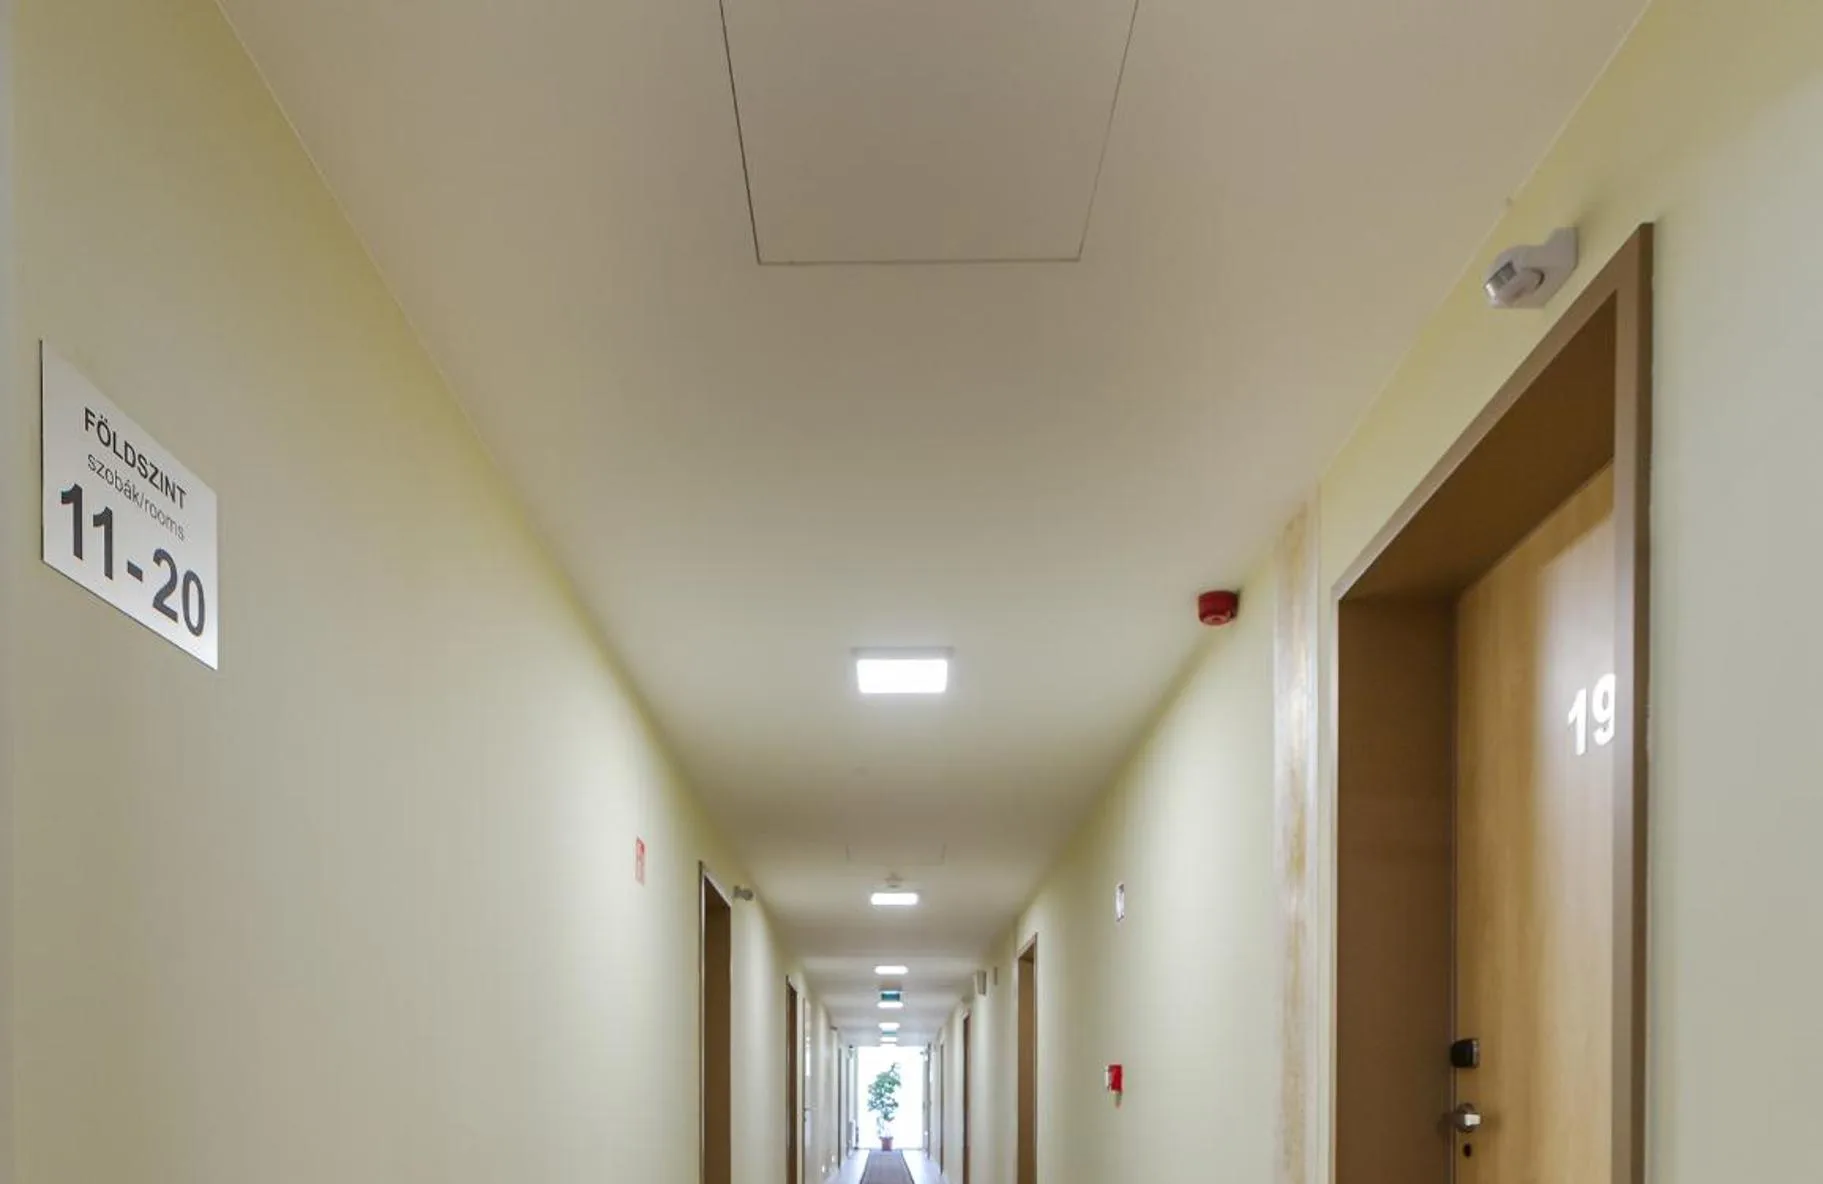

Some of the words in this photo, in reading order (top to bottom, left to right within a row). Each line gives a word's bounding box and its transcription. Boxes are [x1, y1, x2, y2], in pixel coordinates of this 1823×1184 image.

[84, 406, 187, 509] FÖLDSZINT
[87, 453, 185, 541] szobák/rooms
[1567, 672, 1616, 756] 19
